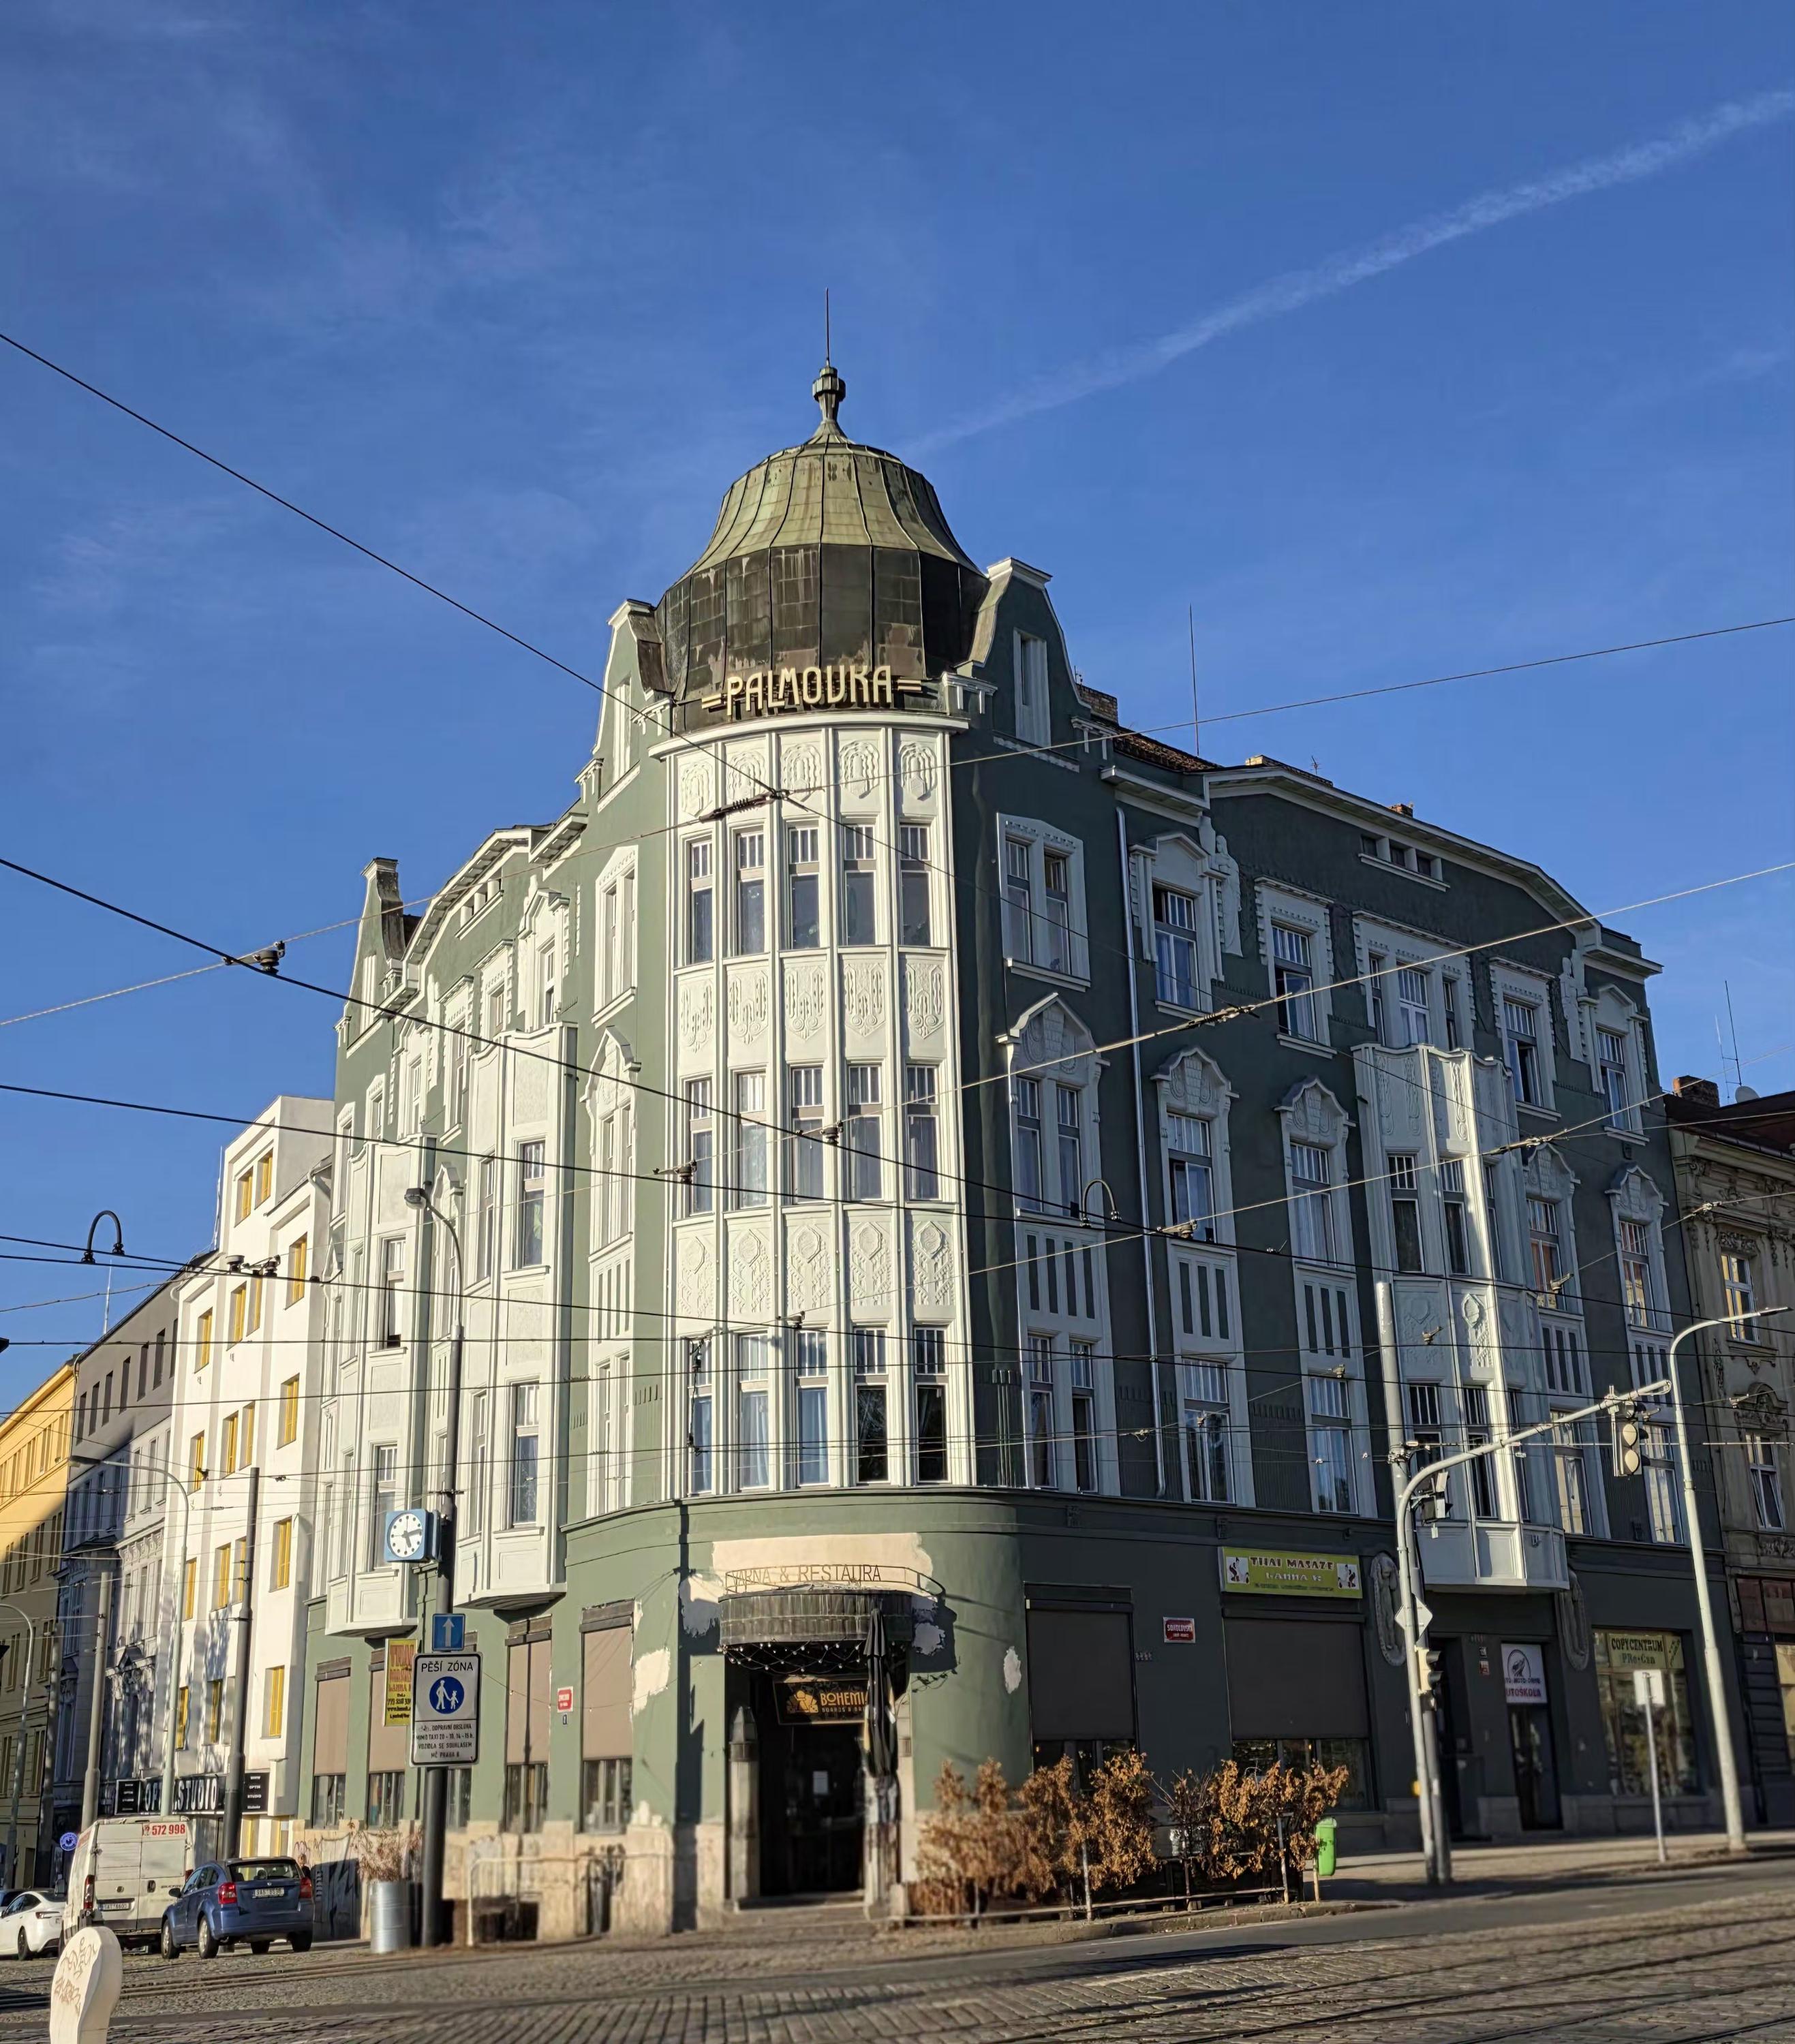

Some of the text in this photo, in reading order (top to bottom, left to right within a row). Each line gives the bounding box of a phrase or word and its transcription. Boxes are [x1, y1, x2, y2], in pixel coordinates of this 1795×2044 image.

[727, 665, 892, 715] PALMOVKA
[1250, 1557, 1281, 1567] THAI
[780, 1568, 790, 1583] &
[798, 1564, 881, 1583] RESTAURA
[1611, 1637, 1663, 1652] COPYCENTRUM
[421, 1660, 474, 1672] PĚŠÍ ZÓNA
[1505, 1686, 1541, 1697] UTOŠKOLA
[152, 1824, 185, 1836] 572 998
